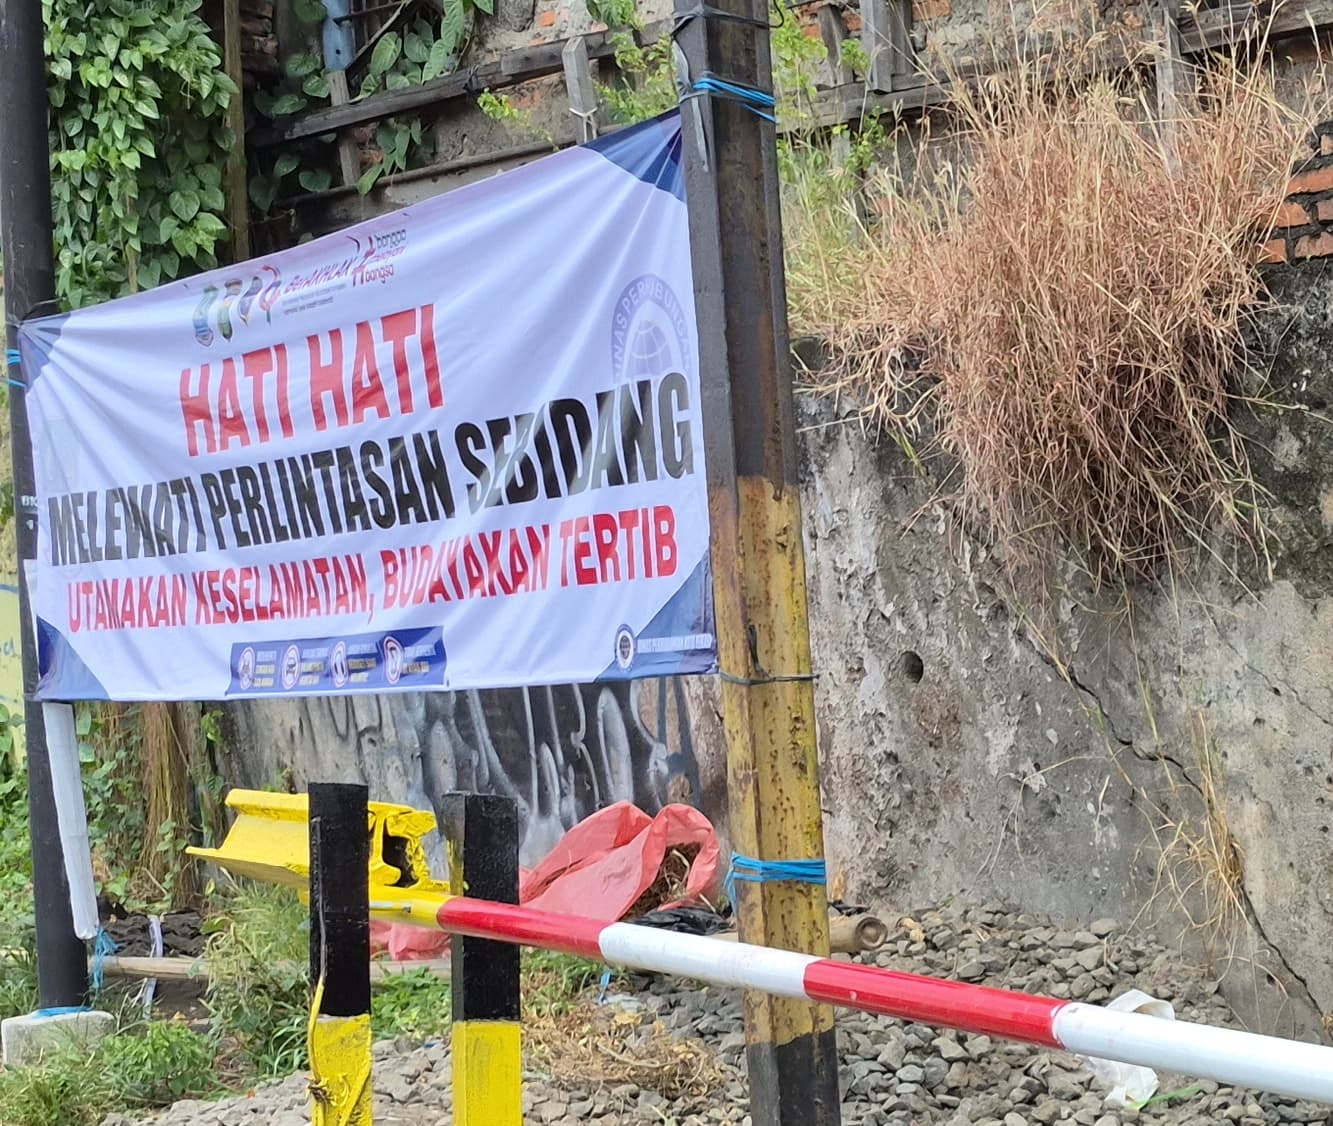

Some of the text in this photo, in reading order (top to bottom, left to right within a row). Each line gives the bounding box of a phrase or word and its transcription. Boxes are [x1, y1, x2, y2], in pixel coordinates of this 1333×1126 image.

[179, 303, 444, 458] HATI HATI
[47, 371, 695, 567] MELEWATI PERLINTASAN SEBIDANG
[67, 504, 679, 633] UTAMAKAN KESELAMATAN, BUDAYAKAN TERTIB
